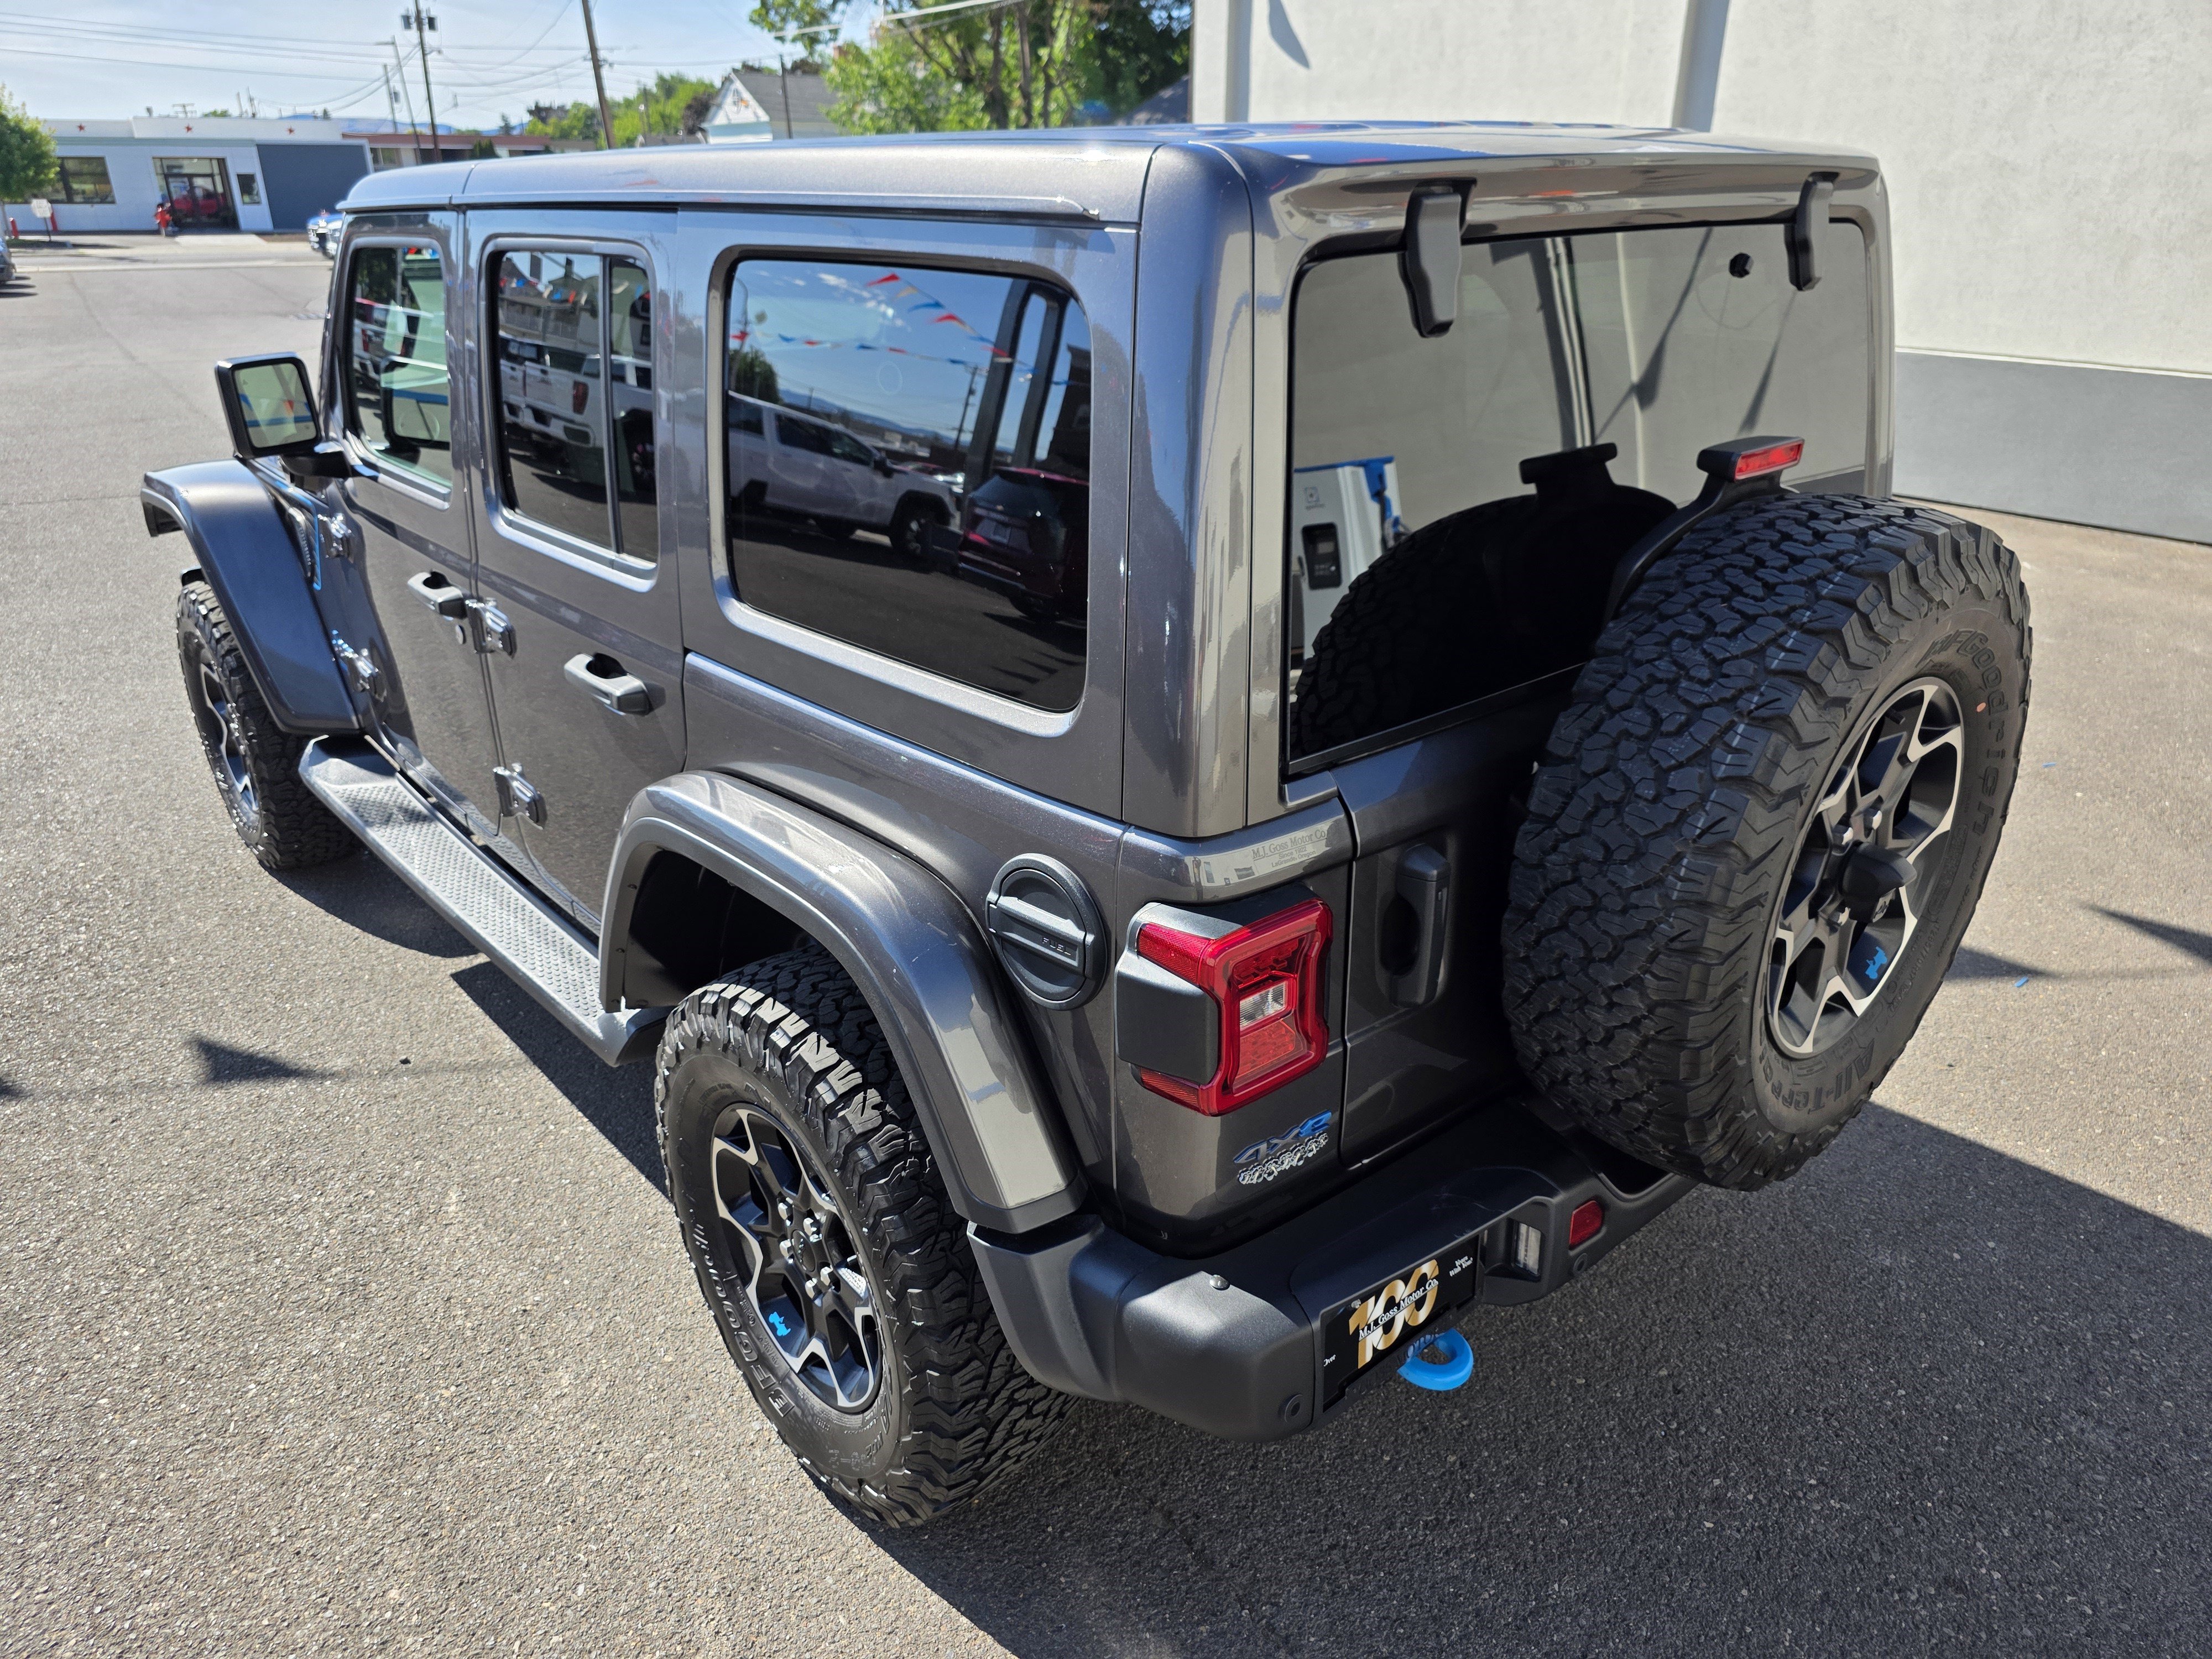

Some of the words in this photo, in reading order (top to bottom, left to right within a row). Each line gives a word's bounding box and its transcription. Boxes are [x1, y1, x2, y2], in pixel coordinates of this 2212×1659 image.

[1251, 846, 1268, 859] M.J.
[1269, 842, 1289, 853] Goss
[1289, 833, 1313, 848] Motor
[1278, 851, 1293, 859] Since
[1297, 850, 1316, 859] Oregon
[1042, 937, 1071, 955] FUEL
[1349, 1259, 1439, 1369] 100
[1378, 1305, 1399, 1325] Goss
[1399, 1286, 1425, 1311] Motor
